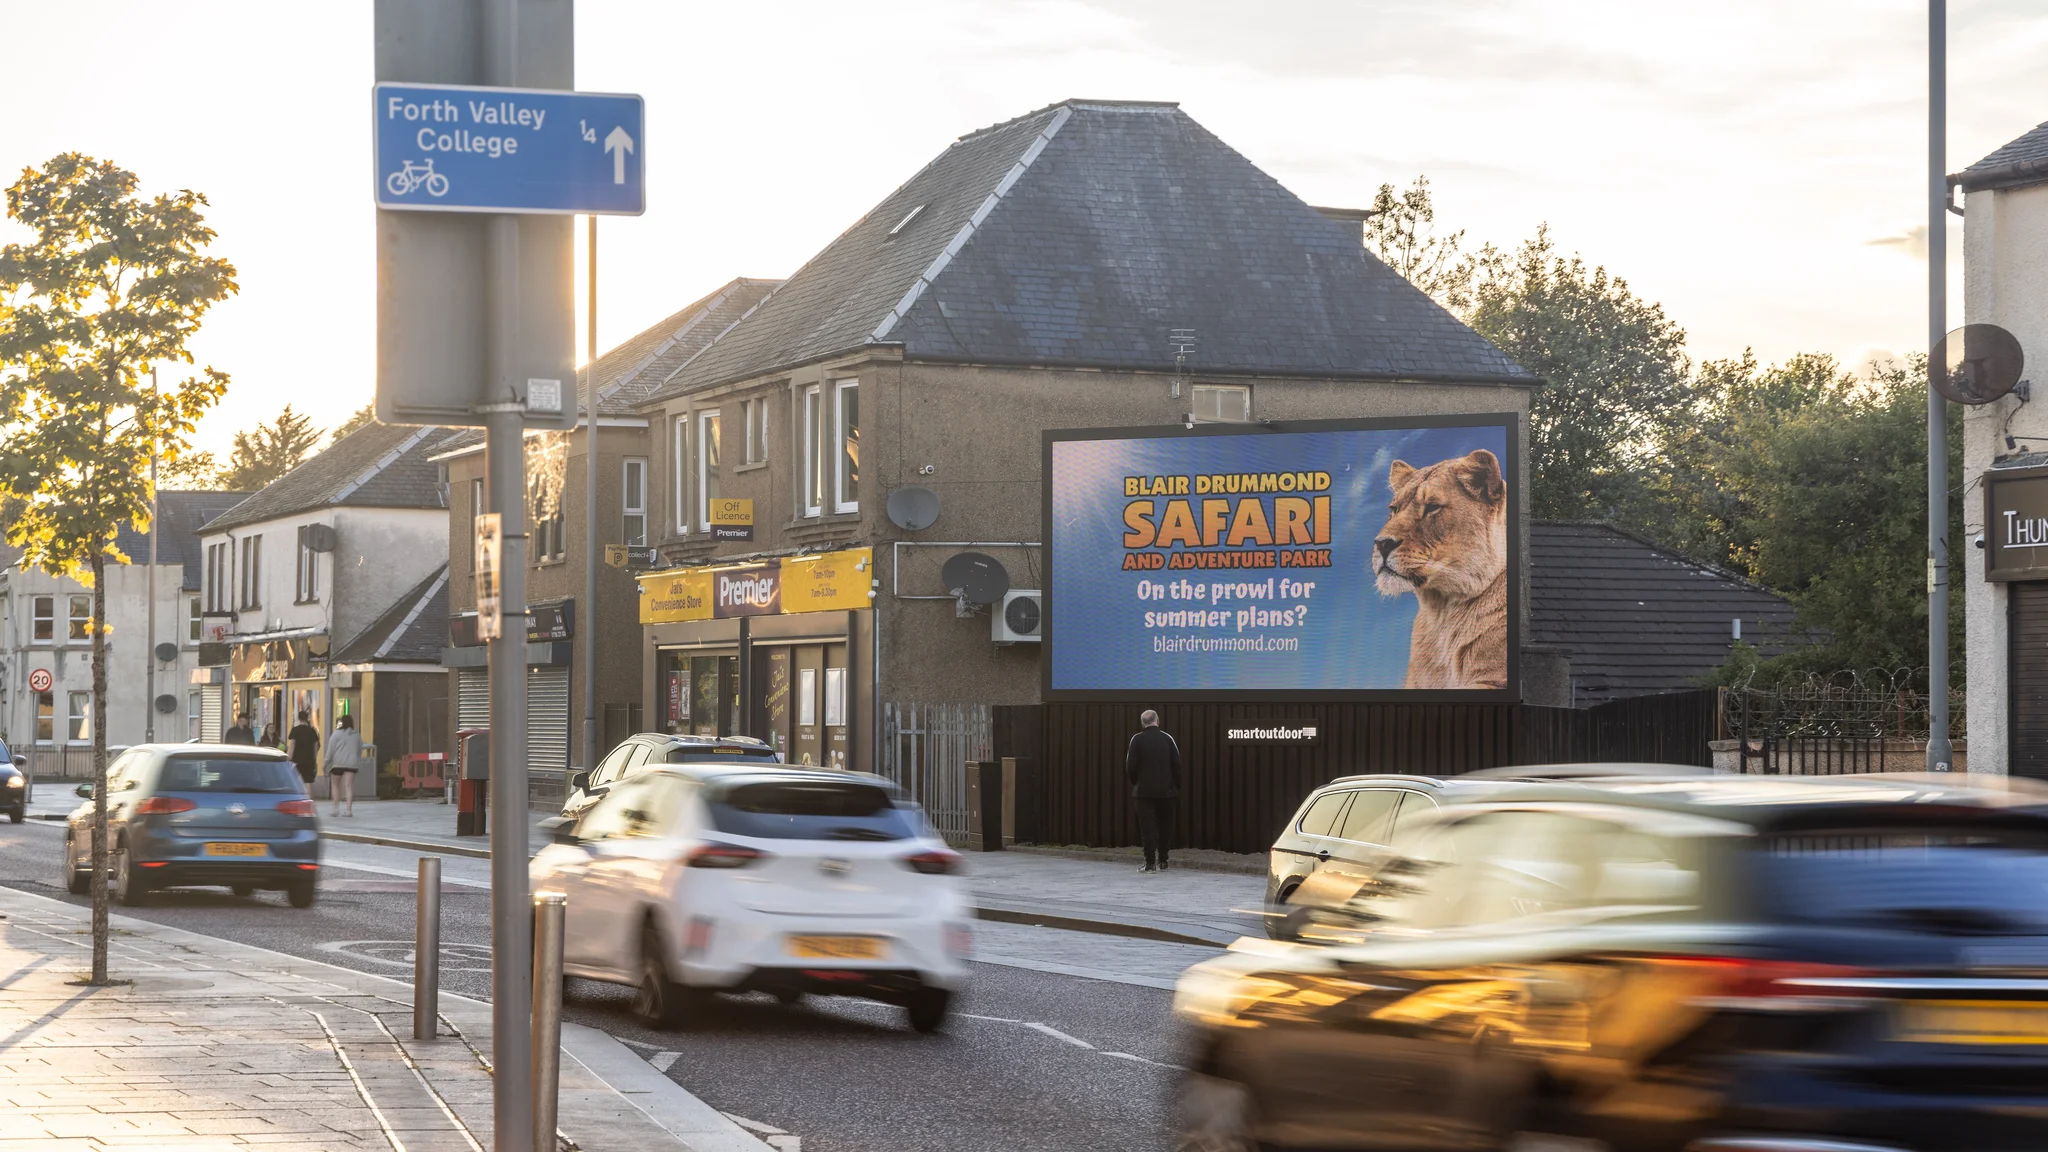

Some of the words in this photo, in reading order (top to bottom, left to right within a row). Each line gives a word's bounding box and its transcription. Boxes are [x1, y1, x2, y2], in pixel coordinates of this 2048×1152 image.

[389, 97, 459, 122] Forth
[469, 101, 546, 130] Valley
[417, 128, 518, 158] College
[1124, 475, 1190, 496] BLAIR
[1195, 471, 1332, 495] DRUMMOND
[716, 511, 750, 521] Licence
[724, 502, 740, 512] Off
[1122, 495, 1332, 548] SAFARI
[717, 529, 748, 537] Premier
[1122, 552, 1165, 570] AND
[1167, 550, 1276, 570] ADVENTURE
[1280, 549, 1332, 568] PARK
[720, 575, 773, 607] Premier
[1137, 580, 1165, 600] On
[1170, 579, 1206, 600] the
[1211, 578, 1274, 605] prowl
[1279, 578, 1316, 598] for
[651, 597, 685, 611] Convenience
[687, 595, 702, 609] Store
[1144, 609, 1231, 628] summer
[1237, 605, 1308, 632] plans?
[1154, 635, 1298, 652] blairdrummond.com
[33, 675, 49, 685] 20
[1228, 726, 1303, 739] smartoutdoor
